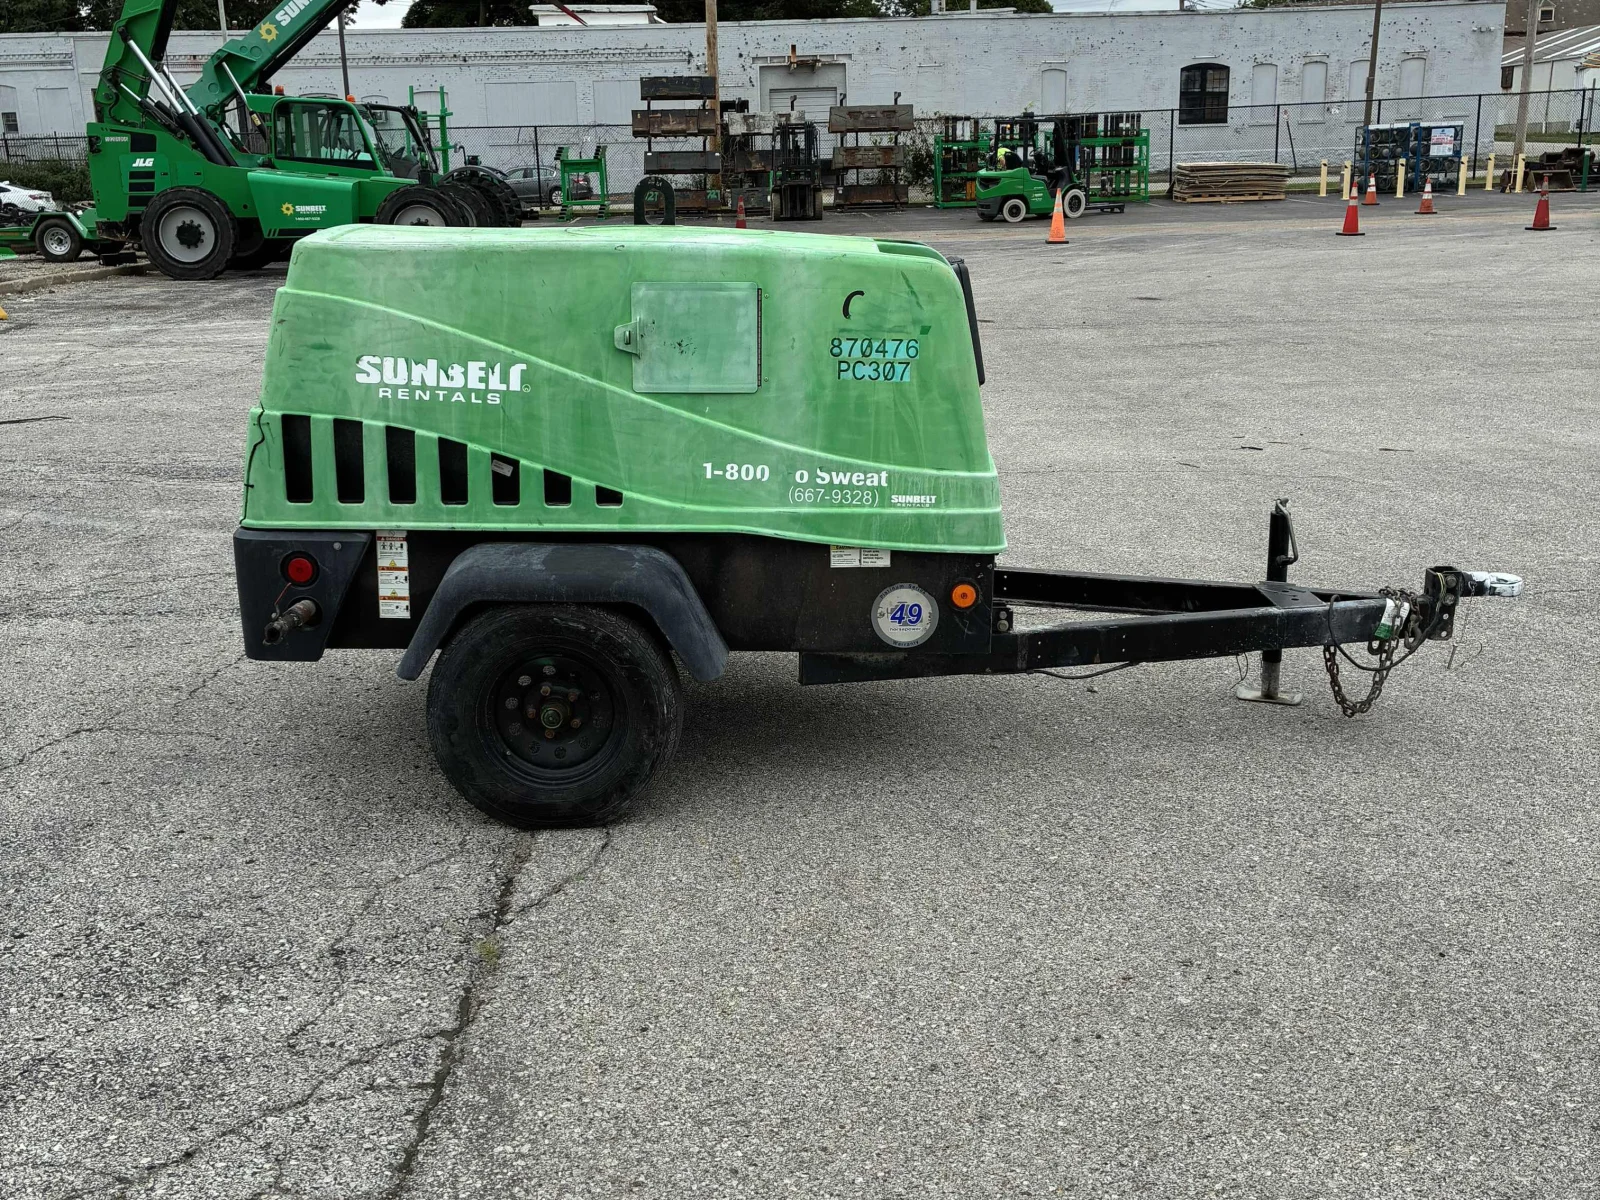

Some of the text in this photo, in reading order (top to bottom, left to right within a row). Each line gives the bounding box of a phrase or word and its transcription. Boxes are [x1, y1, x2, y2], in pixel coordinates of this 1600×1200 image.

[275, 0, 313, 26] SUN
[132, 158, 155, 167] JLG
[829, 337, 919, 359] 870476
[355, 354, 528, 392] SUNBELT
[837, 360, 911, 381] PC307
[378, 387, 501, 405] RENTALS
[702, 462, 770, 482] 1-800
[815, 467, 888, 487] Sweat
[788, 485, 880, 507] (667-9328)
[891, 494, 937, 503] SUNBELT
[880, 583, 926, 600] Platinum Series
[889, 603, 923, 626] 49
